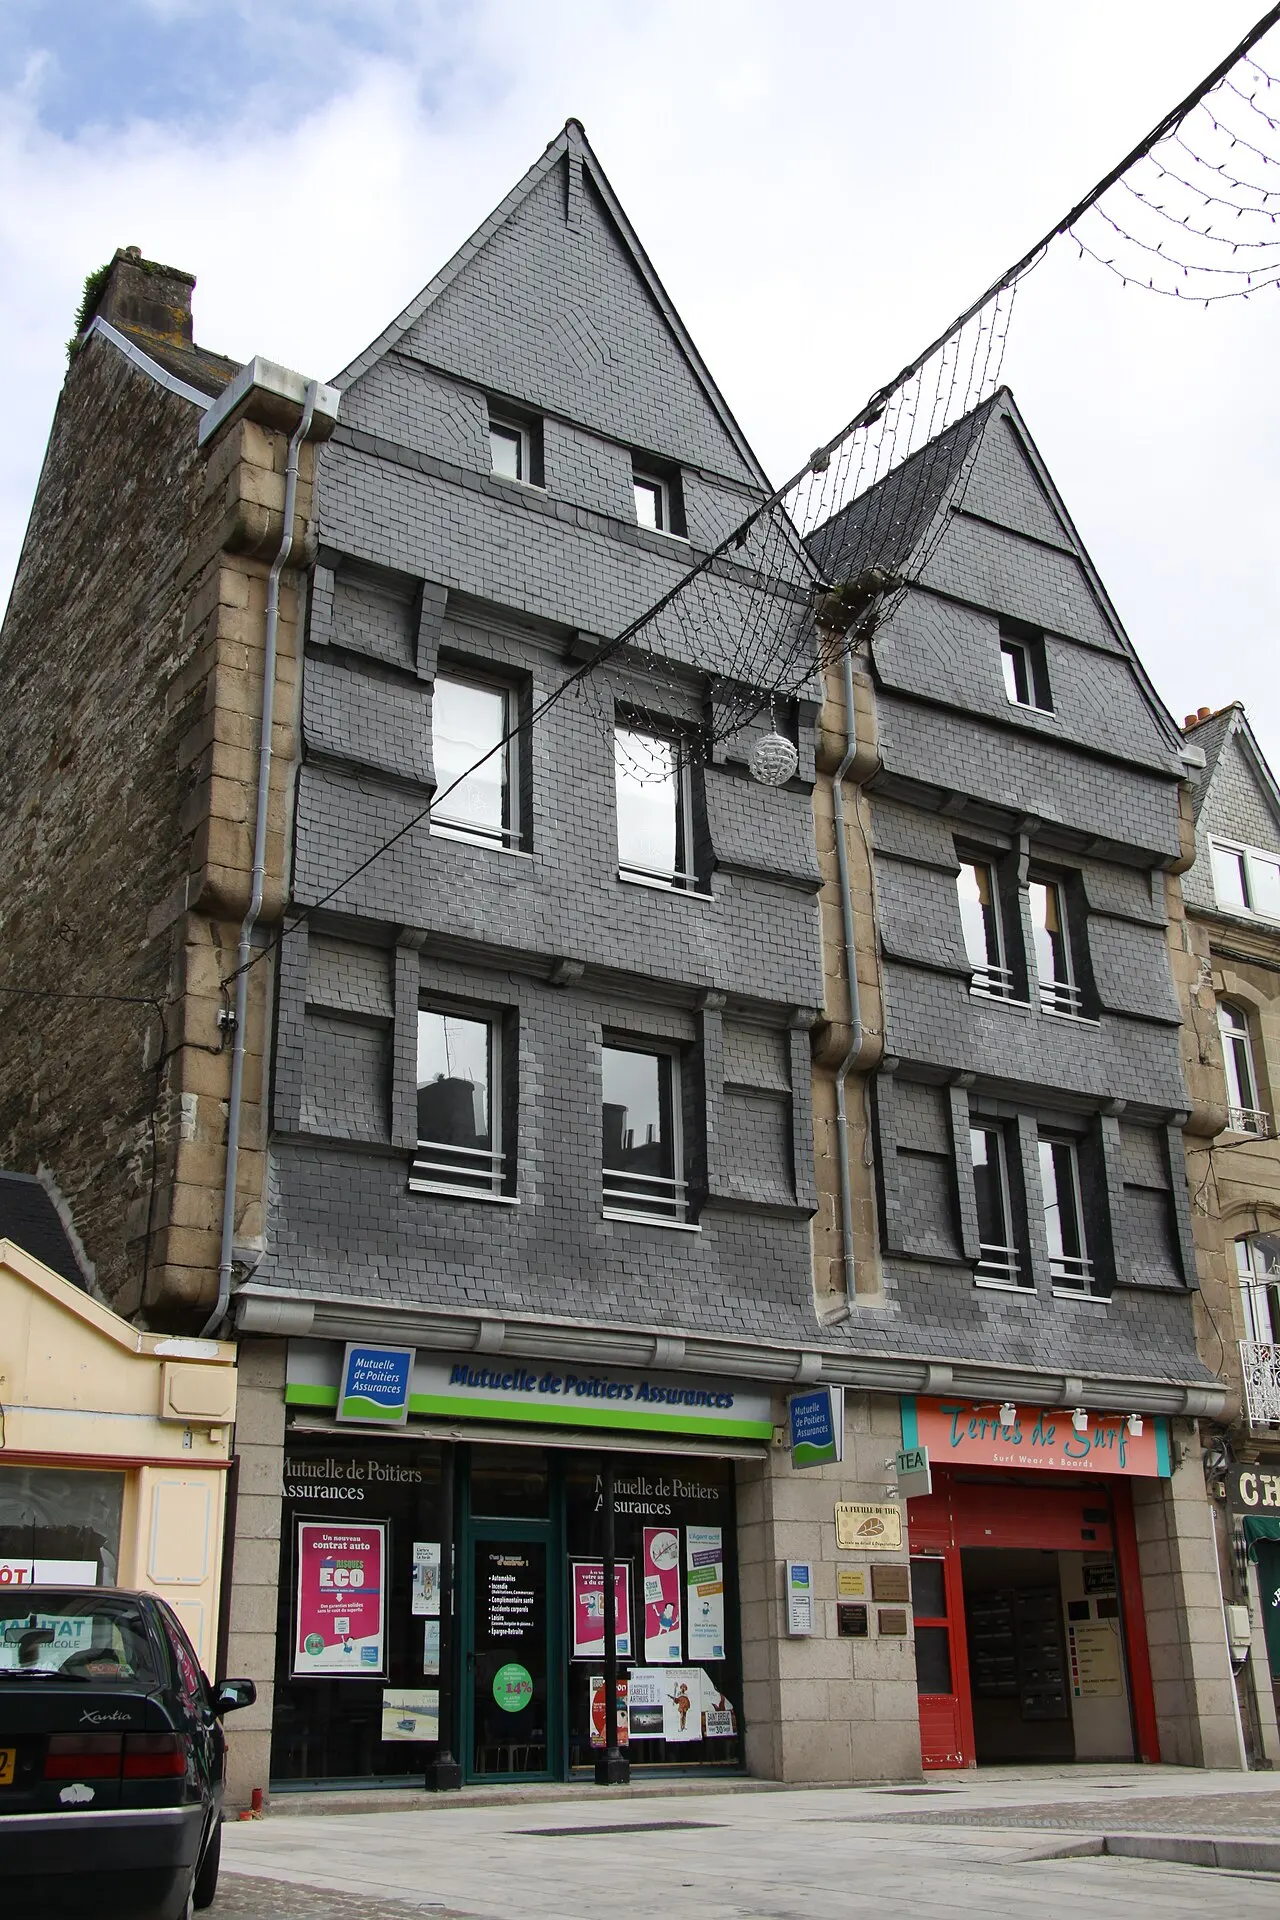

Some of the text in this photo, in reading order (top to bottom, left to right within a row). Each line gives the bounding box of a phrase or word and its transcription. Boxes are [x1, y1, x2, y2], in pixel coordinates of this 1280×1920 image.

[355, 1358, 395, 1370] Mutuelle
[353, 1370, 400, 1383] de Poitiers
[352, 1381, 401, 1394] Assurances
[449, 1364, 735, 1410] Mutuelle de Poitiers Assurances
[794, 1402, 820, 1417] Mutuelle
[795, 1414, 826, 1428] de Poitiers
[940, 1404, 1023, 1448] Terres
[1031, 1411, 1056, 1446] de
[796, 1424, 829, 1438] Assurances
[898, 1451, 924, 1471] TEA
[992, 1453, 1094, 1468] Surf Wear & Boards
[346, 1459, 365, 1481] de
[367, 1460, 423, 1484] Poitiers
[654, 1477, 671, 1496] de
[672, 1478, 720, 1500] Poitiers
[840, 1505, 849, 1513] LA
[850, 1506, 873, 1514] FEUILLE
[312, 1541, 371, 1551] contrat auto
[491, 1574, 516, 1582] Automobiles
[79, 1710, 132, 1724] Xantia
[715, 1725, 724, 1735] 30
